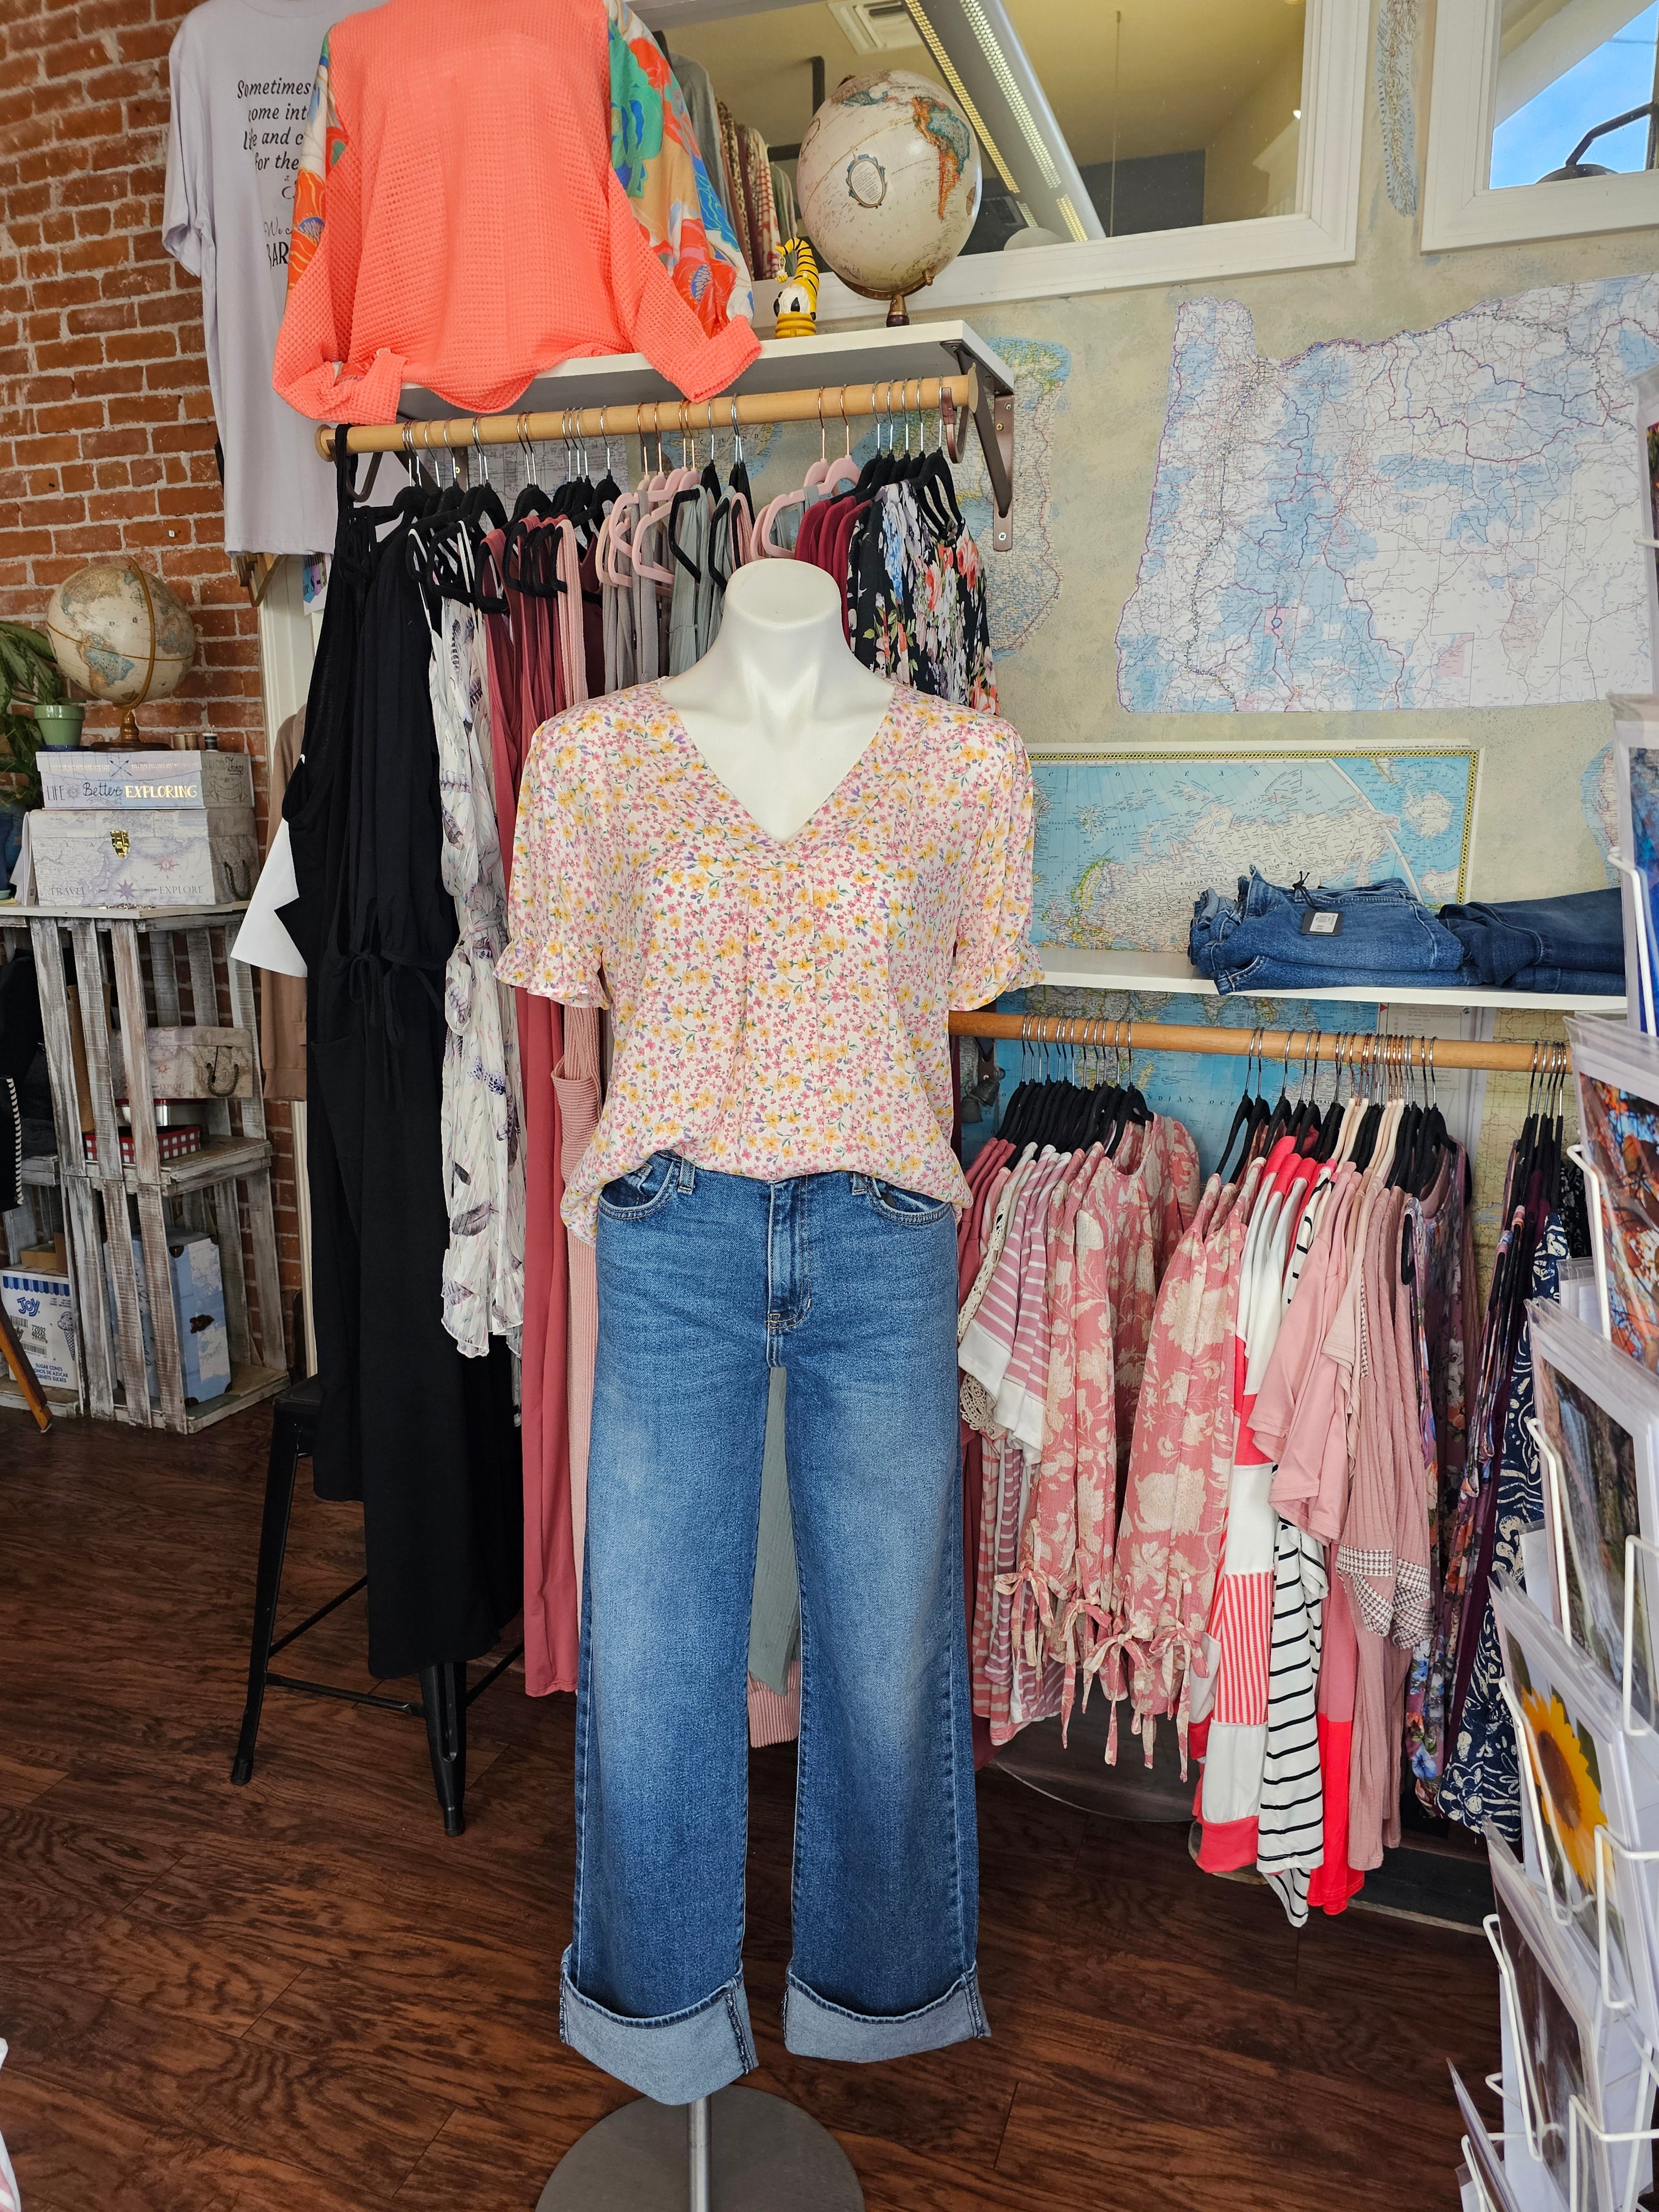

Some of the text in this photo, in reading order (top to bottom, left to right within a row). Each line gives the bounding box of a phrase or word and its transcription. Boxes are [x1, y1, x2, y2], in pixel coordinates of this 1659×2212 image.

[237, 77, 311, 99] Sometimes
[285, 102, 308, 120] int
[262, 127, 291, 145] and
[275, 150, 299, 170] the
[263, 216, 283, 237] We
[46, 785, 66, 801] LIFE
[82, 782, 123, 796] Better
[124, 785, 197, 798] EXPLORING
[160, 886, 204, 894] EXPLORE
[1146, 1094, 1194, 1103] NDIAN
[17, 1296, 40, 1317] Joy
[32, 1324, 46, 1334] 72092
